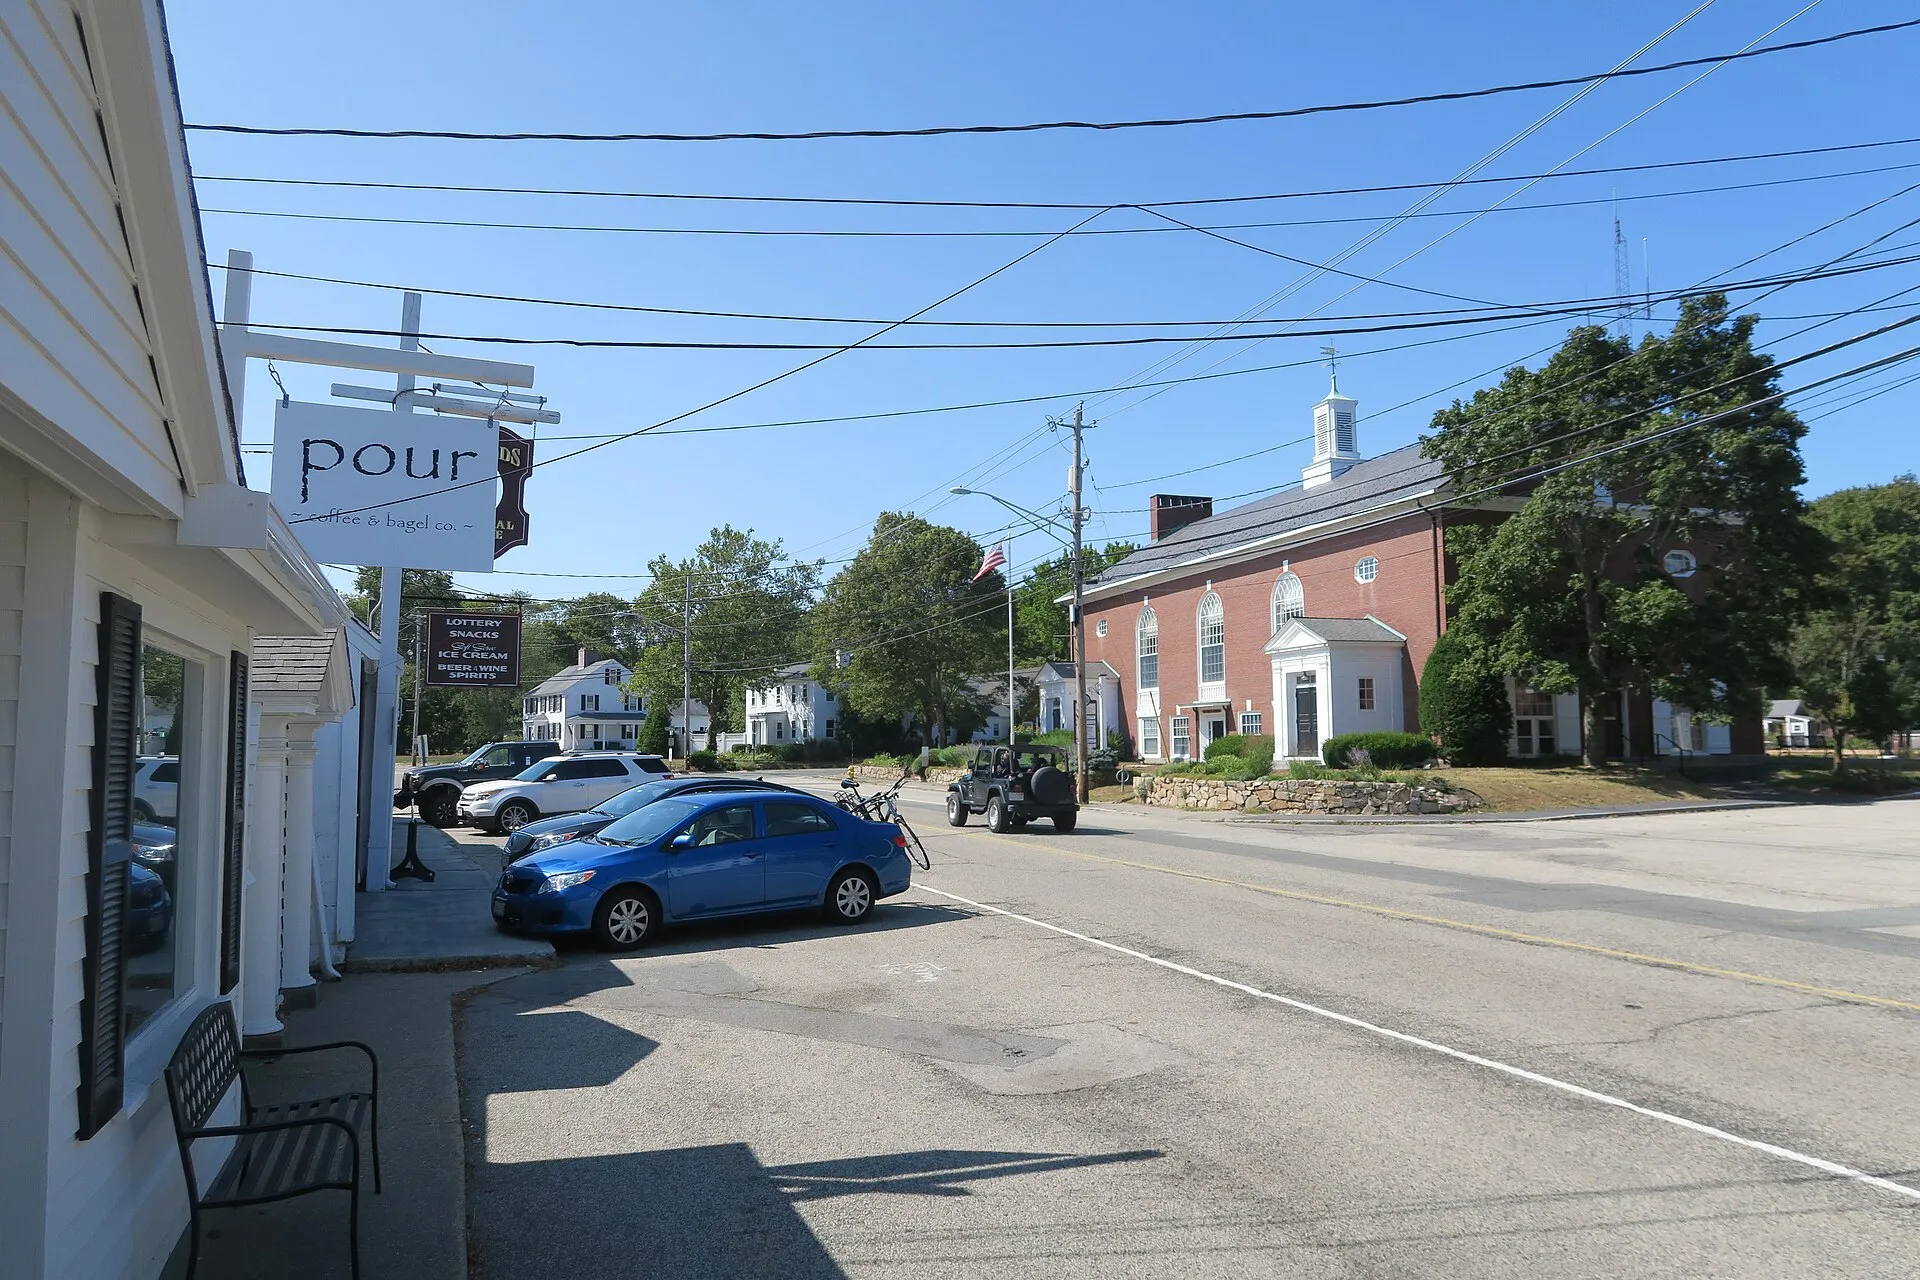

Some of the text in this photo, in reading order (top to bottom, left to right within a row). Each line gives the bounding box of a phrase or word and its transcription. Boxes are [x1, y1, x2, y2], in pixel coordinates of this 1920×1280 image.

[499, 446, 521, 467] DS
[300, 438, 479, 504] pour
[308, 507, 457, 534] coffee & bagel co.
[496, 520, 515, 531] AL
[446, 618, 503, 627] LOTTERY
[449, 630, 500, 639] SNACKS
[438, 650, 509, 660] ICE CREAM
[437, 663, 472, 672] BEER
[479, 665, 508, 673] WINE
[449, 672, 497, 680] SPIRITS
